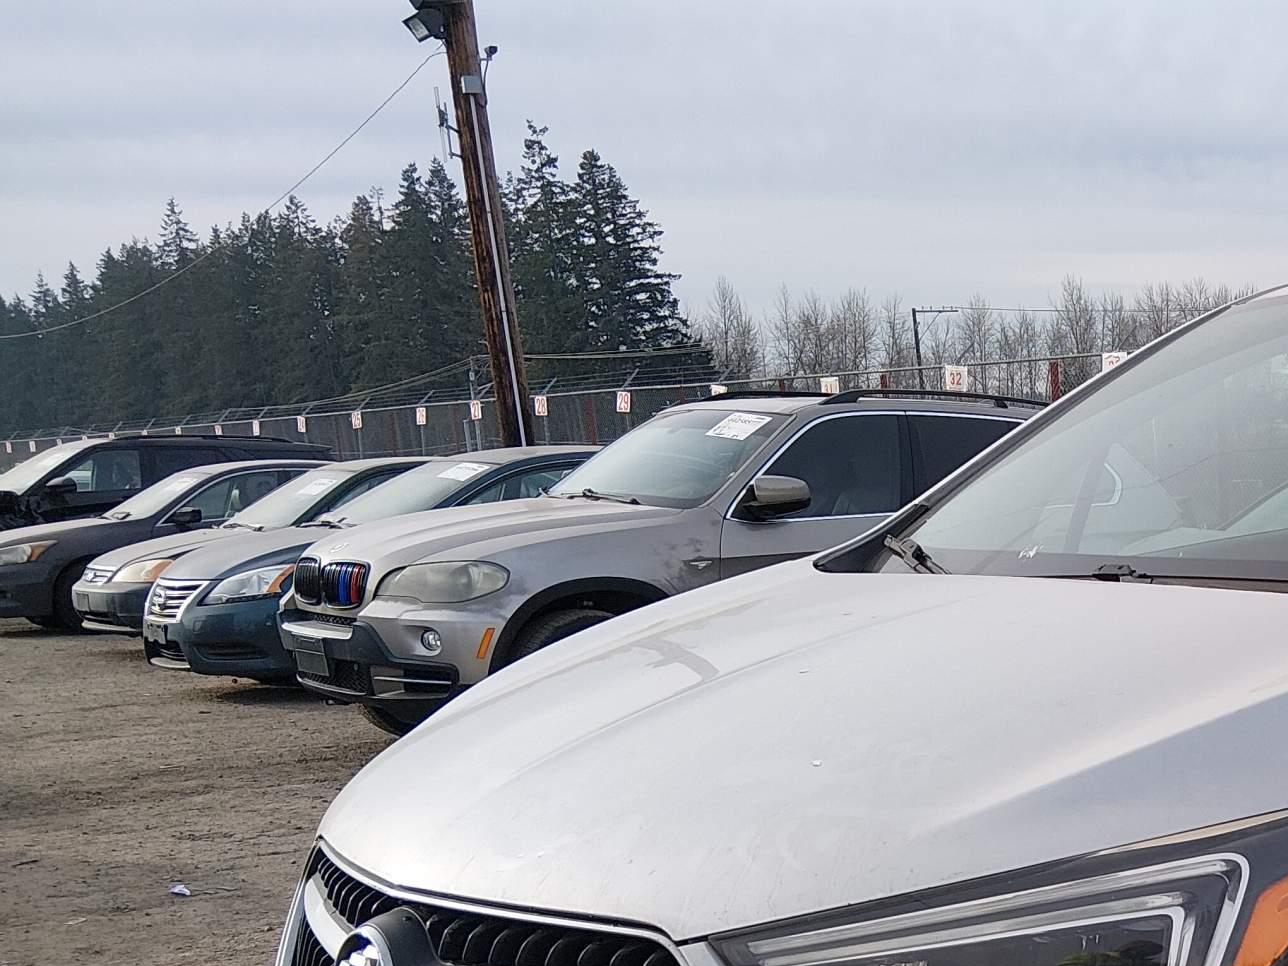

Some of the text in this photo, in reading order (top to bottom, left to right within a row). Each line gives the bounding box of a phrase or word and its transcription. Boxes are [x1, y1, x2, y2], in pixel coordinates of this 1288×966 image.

[949, 372, 962, 387] 32
[536, 398, 547, 415] 28
[618, 393, 630, 411] 29
